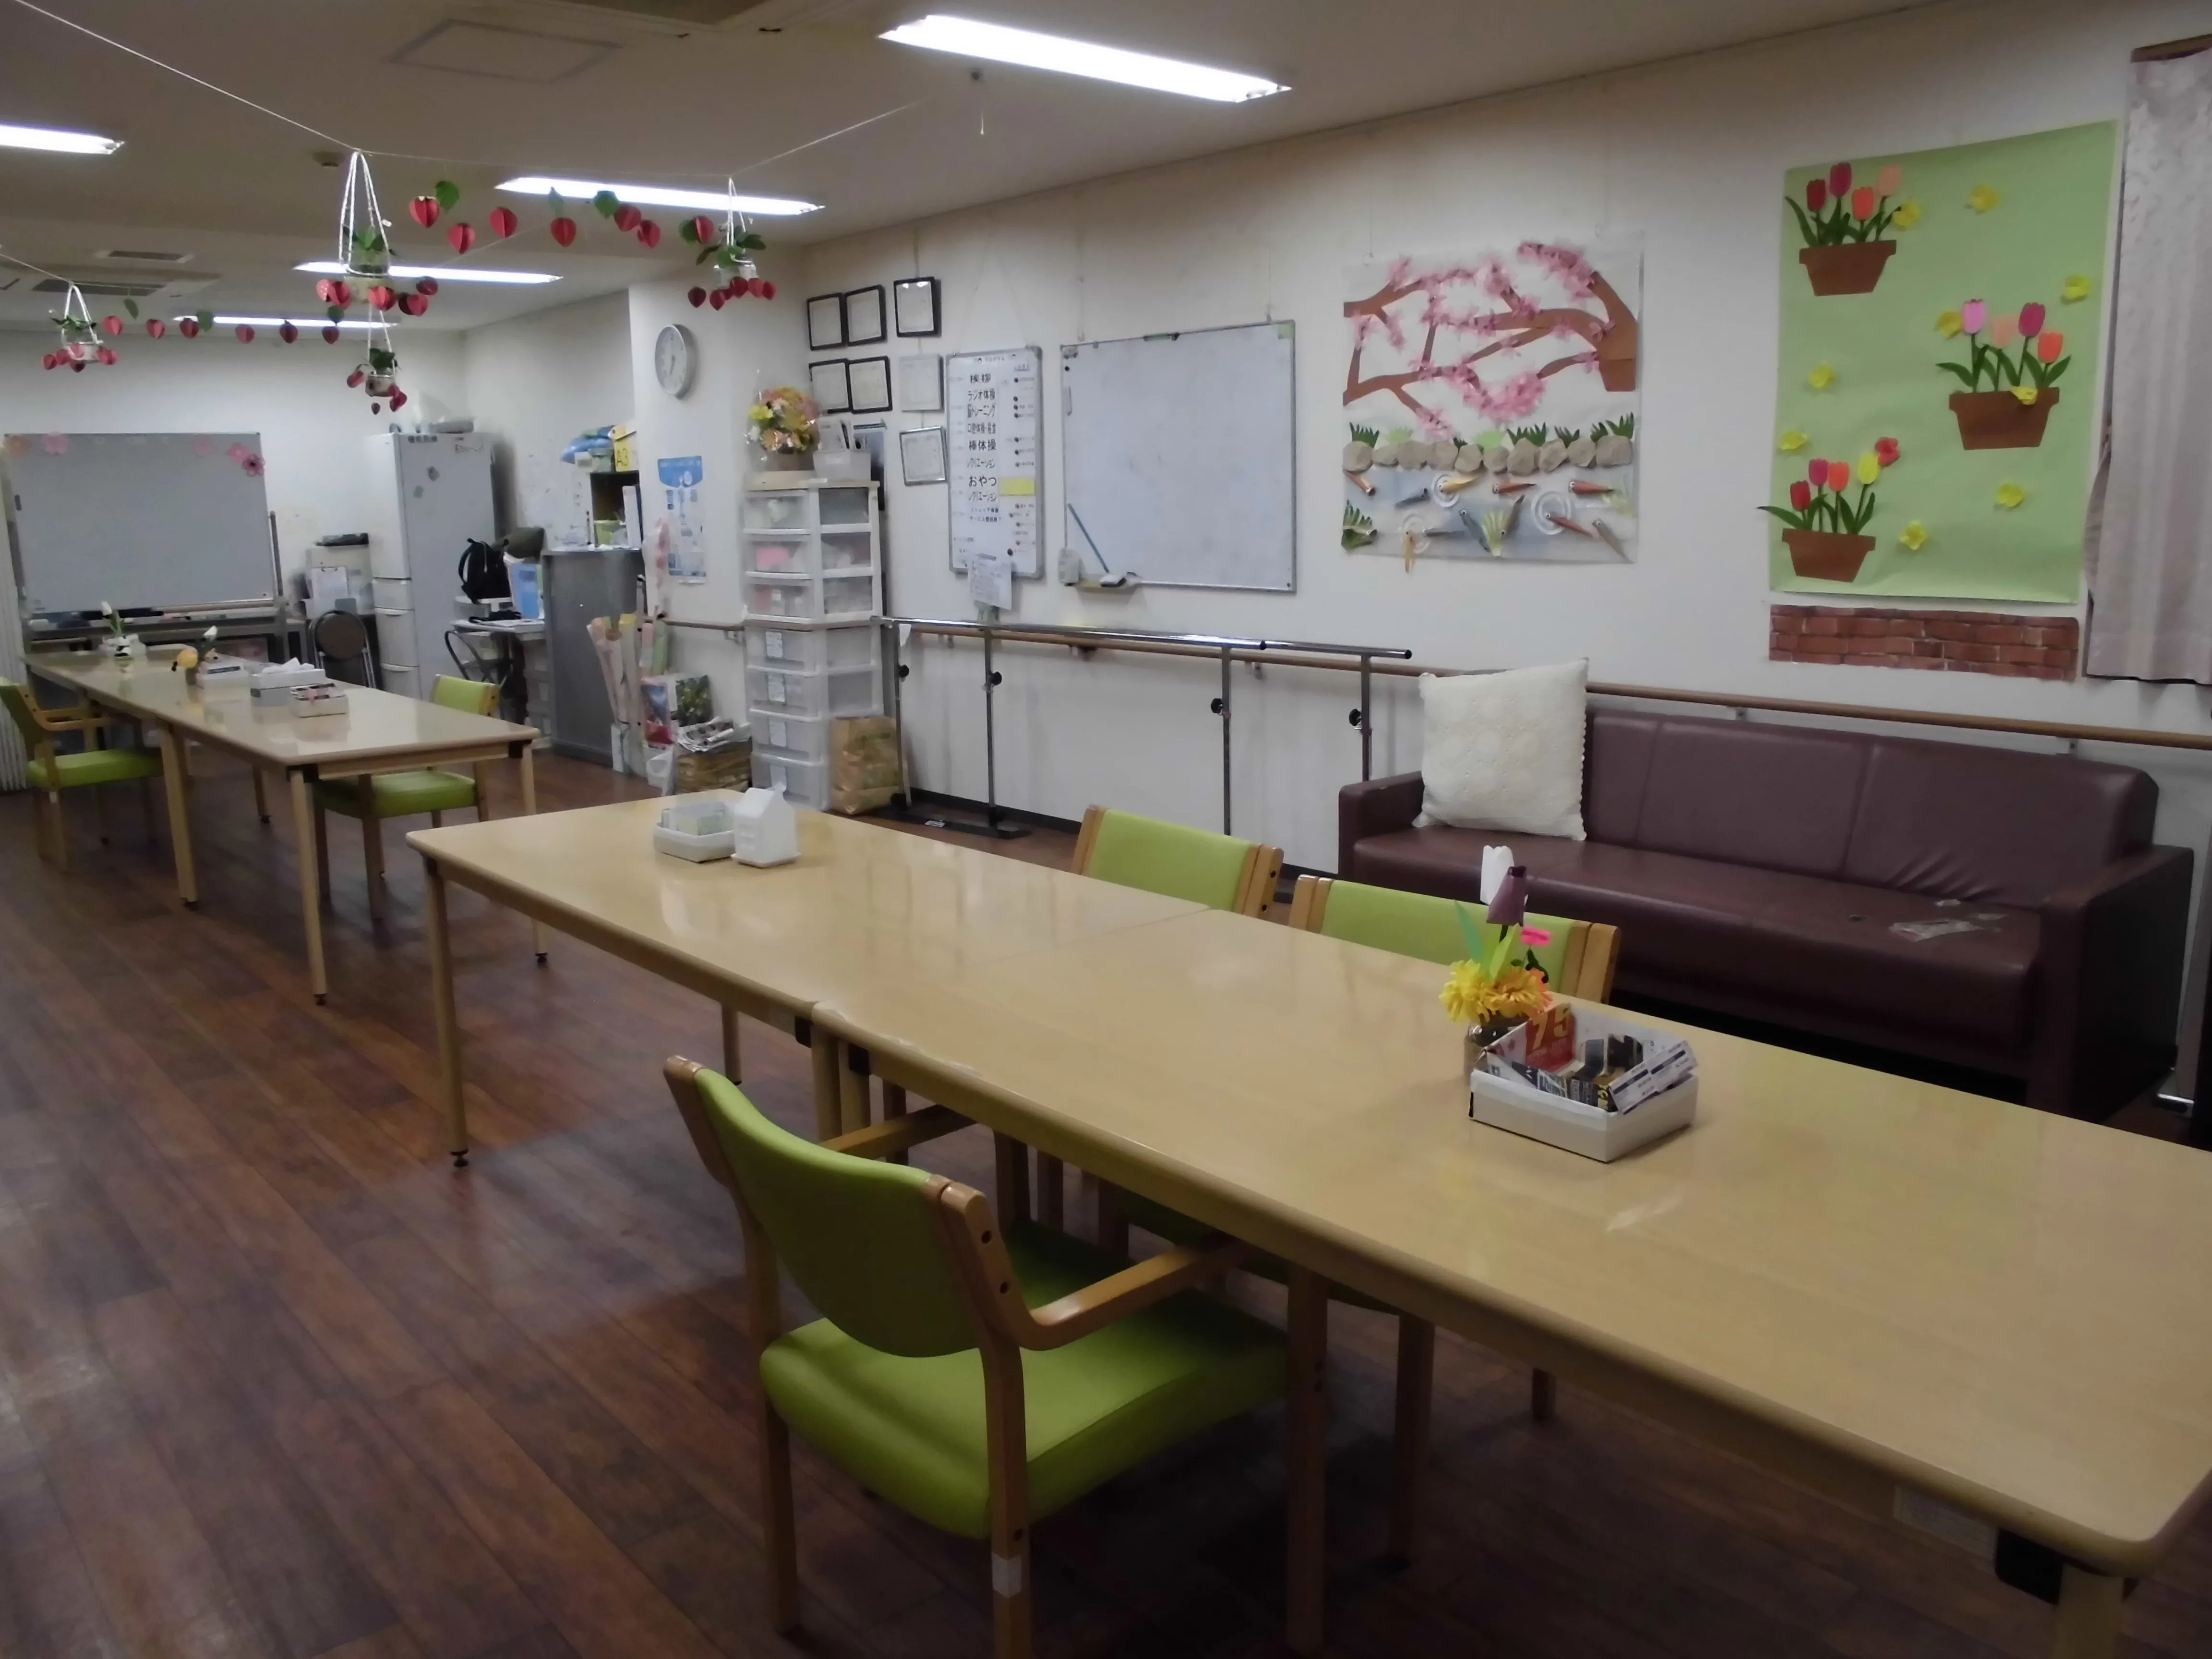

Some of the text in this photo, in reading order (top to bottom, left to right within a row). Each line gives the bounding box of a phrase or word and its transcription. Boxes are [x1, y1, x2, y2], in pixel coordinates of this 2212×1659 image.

[970, 373, 992, 384] 挨拶
[968, 388, 996, 401] ラジオ体操
[969, 439, 997, 451] 棒体操
[616, 448, 629, 467] A3
[969, 476, 997, 487] おやつ
